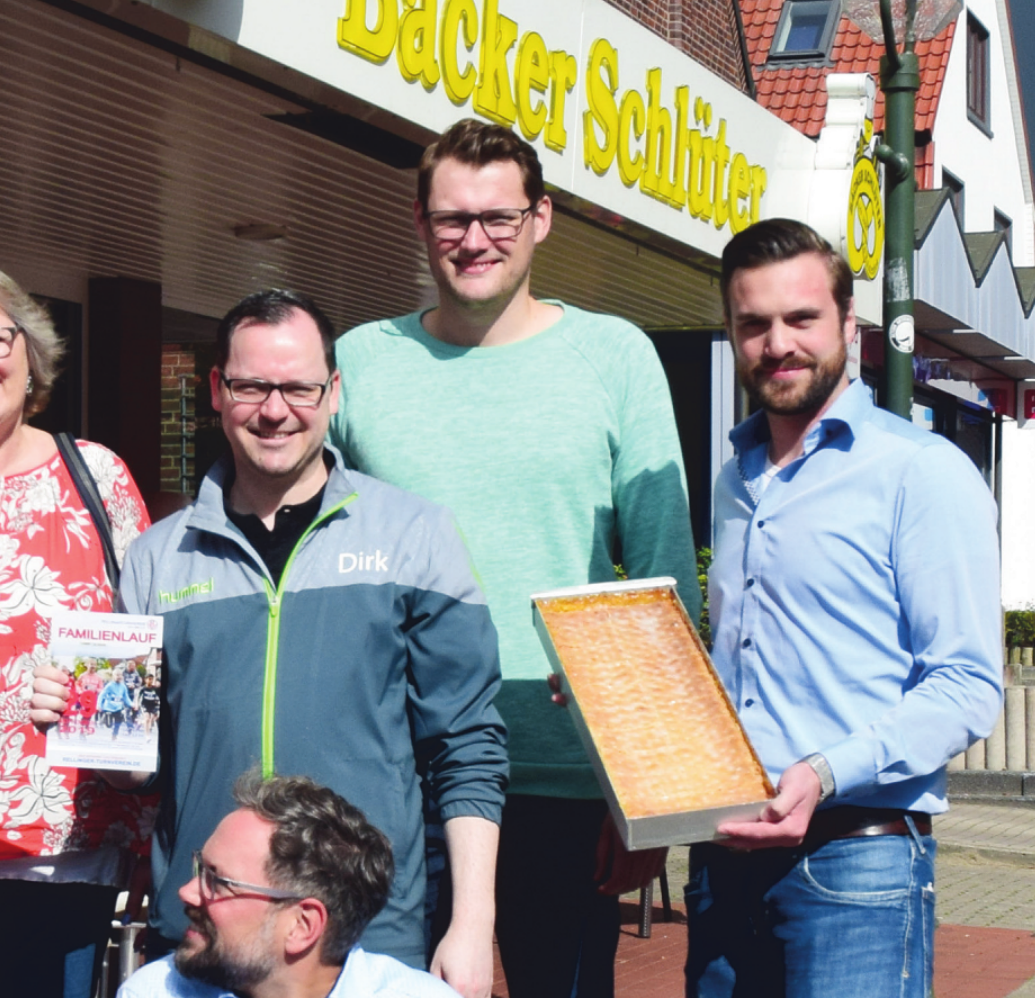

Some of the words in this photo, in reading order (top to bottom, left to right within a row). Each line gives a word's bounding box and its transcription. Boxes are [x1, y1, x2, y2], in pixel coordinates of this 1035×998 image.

[583, 38, 766, 236] Schlüter
[338, 549, 389, 574] Dirk
[159, 577, 214, 603] hummel
[58, 627, 157, 643] FAMILIENLAUF
